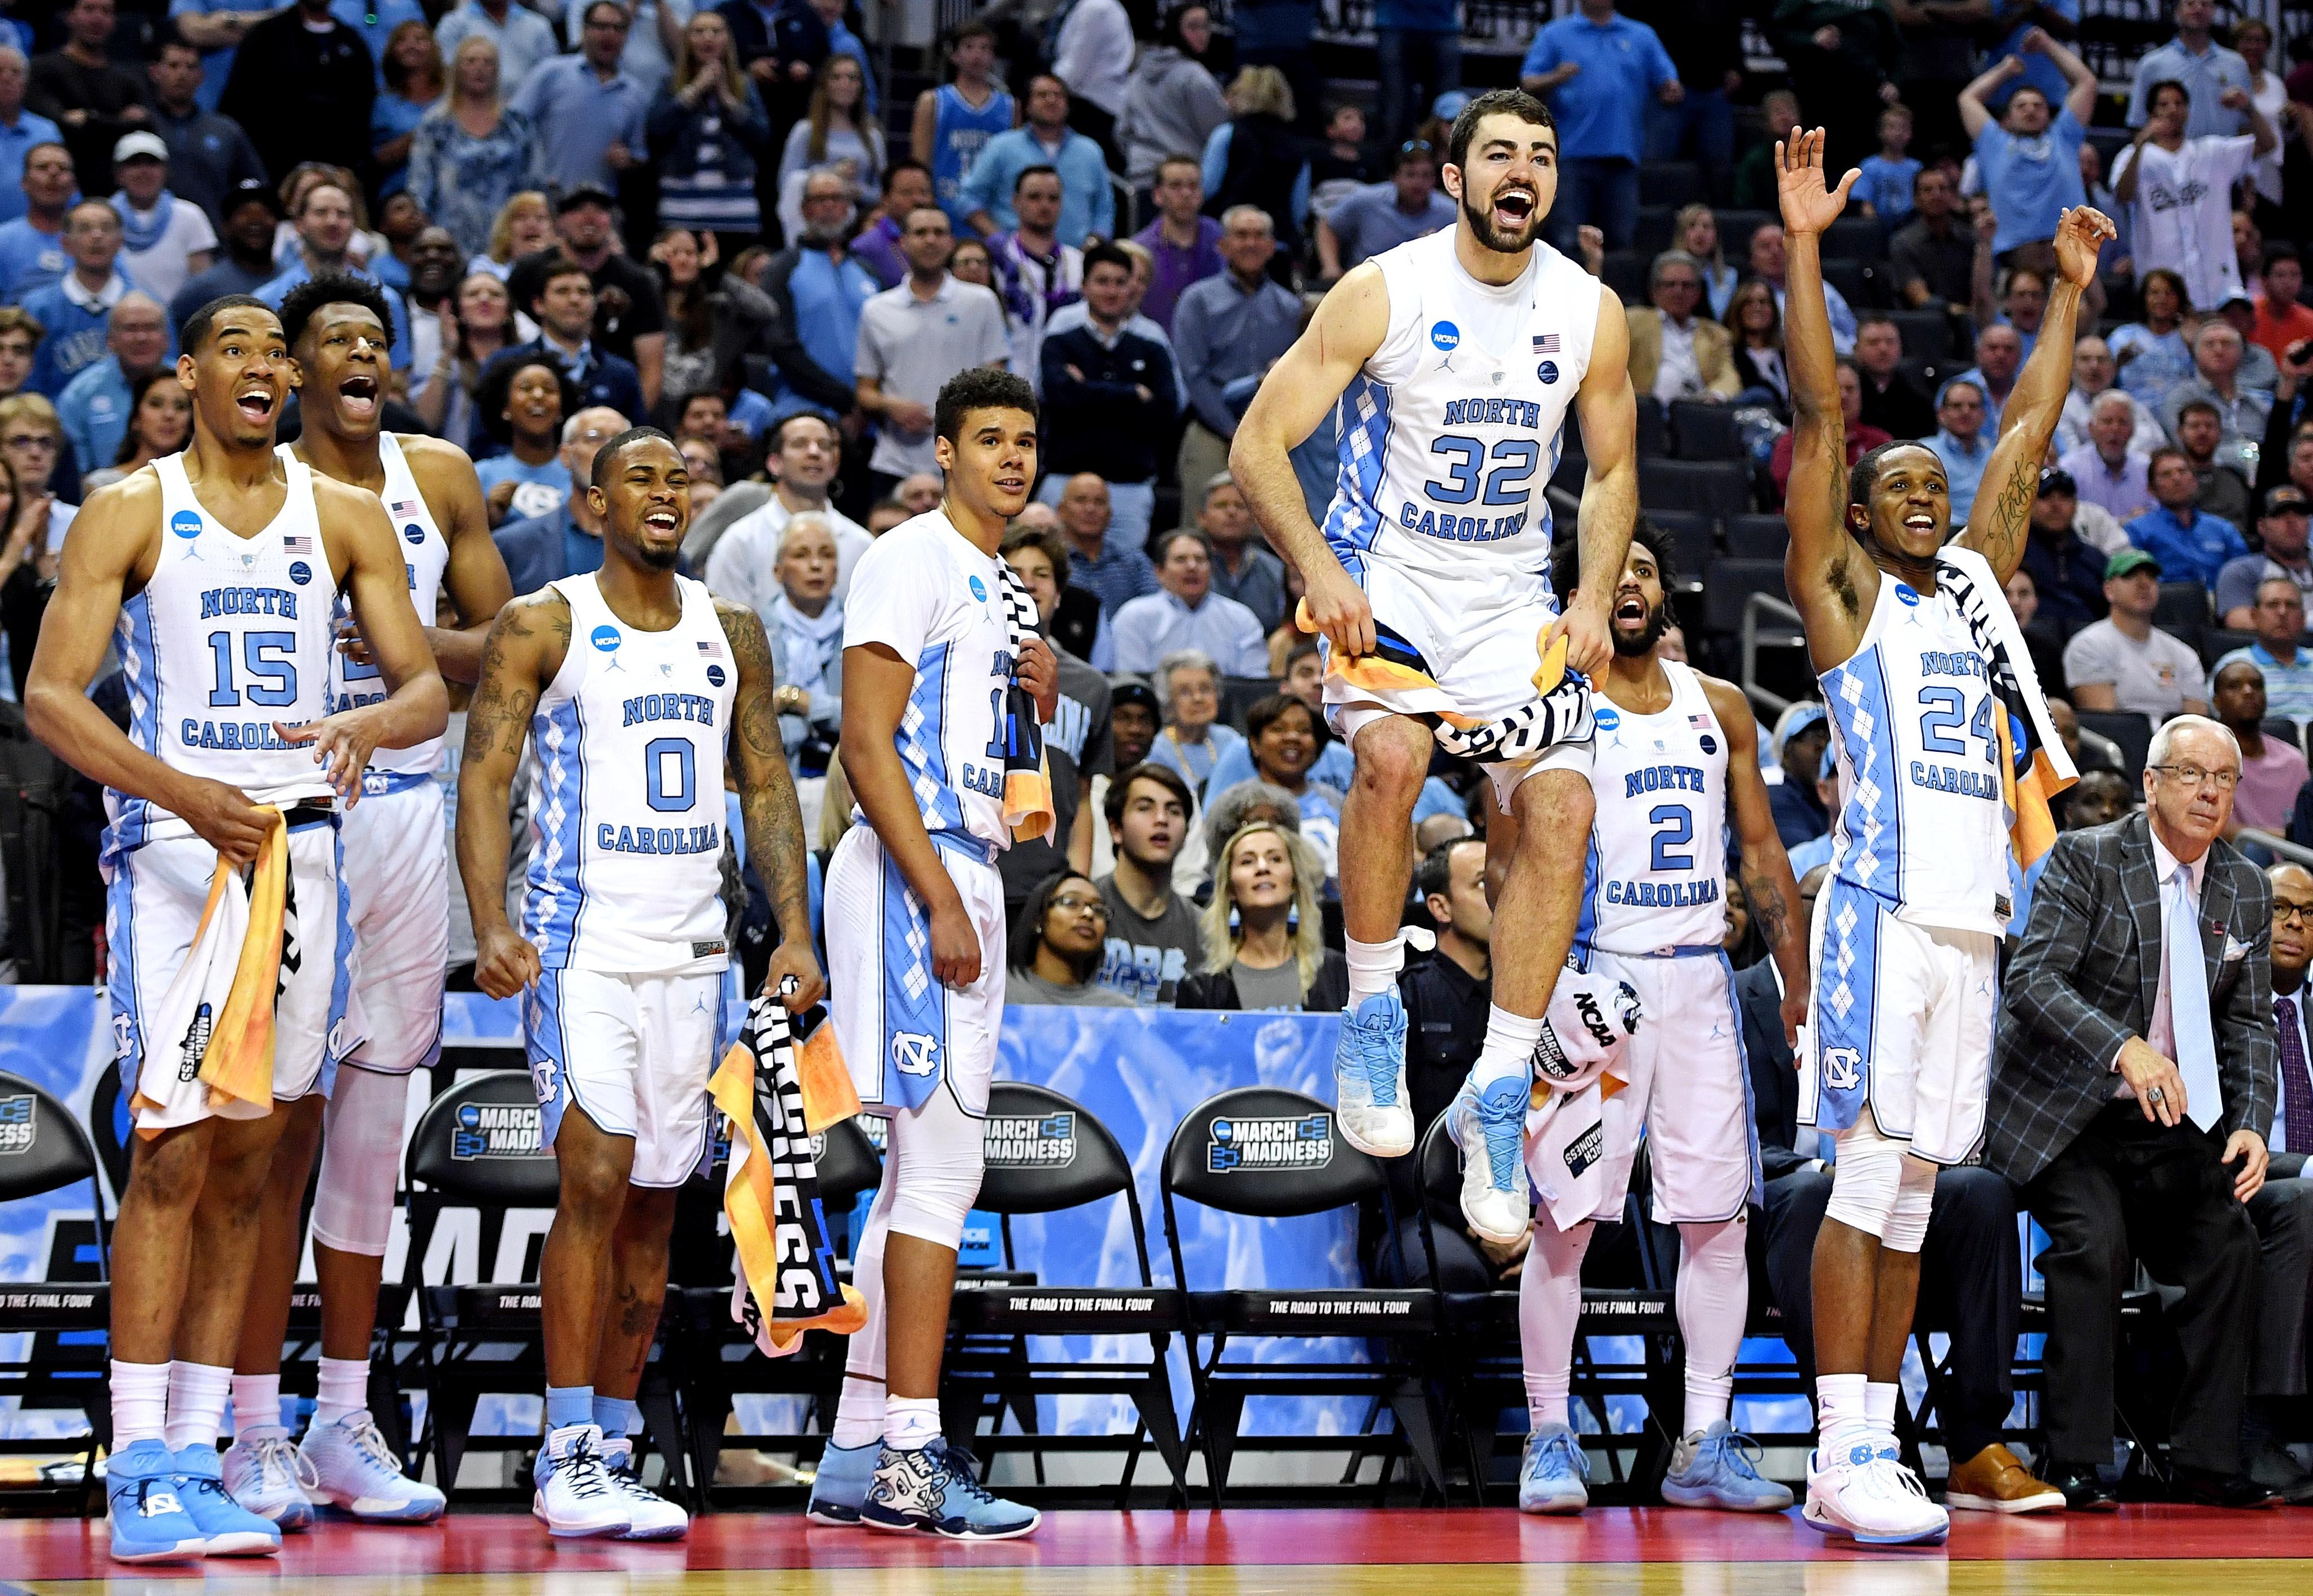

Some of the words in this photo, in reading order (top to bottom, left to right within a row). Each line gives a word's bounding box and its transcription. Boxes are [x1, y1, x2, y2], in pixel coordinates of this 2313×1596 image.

[1434, 333, 1458, 345] NCAA
[1444, 398, 1540, 429] NORTH
[1424, 434, 1540, 505] 32
[174, 523, 201, 532] NCAA
[1400, 502, 1529, 541] CAROLIN
[201, 587, 297, 620] NORTH
[1898, 592, 1919, 603] NCAA
[595, 637, 620, 646] NCAA
[208, 631, 297, 707] 15
[623, 693, 714, 727] NORTH
[1598, 718, 1618, 726] NCAA
[1918, 686, 1996, 764] 24
[645, 737, 695, 812] 0
[1625, 765, 1705, 799] NORTH
[598, 823, 719, 855] CAROLINA
[1649, 804, 1693, 871] 2
[1606, 877, 1719, 908] CAROLINA
[1573, 993, 1617, 1048] NCAA
[1541, 1026, 1563, 1061] MARCH
[1232, 1121, 1297, 1142] MARCH
[985, 1138, 1073, 1159] MADNESS
[1242, 1139, 1330, 1161] MADNESS
[7, 1295, 29, 1308] THE
[30, 1295, 61, 1308] FINAL
[62, 1295, 94, 1308] FOUR
[291, 1294, 306, 1307] HE
[499, 1296, 520, 1308] THE
[521, 1296, 542, 1308] ROA
[1010, 1298, 1029, 1311] THE
[1030, 1298, 1058, 1311] ROAD
[1059, 1299, 1073, 1311] TO
[1075, 1299, 1094, 1311] THE
[1095, 1299, 1123, 1311] FINAL
[1125, 1299, 1153, 1311] FOUR
[1270, 1301, 1289, 1313] THE
[1290, 1301, 1318, 1314] ROAD
[1319, 1301, 1332, 1314] TO
[1333, 1301, 1352, 1314] THE
[1353, 1301, 1381, 1314] FINAL
[1383, 1301, 1410, 1314] FOUR
[1590, 1302, 1608, 1314] THE
[1609, 1301, 1636, 1314] FINAL
[1638, 1301, 1665, 1314] FOUR
[907, 1451, 934, 1477] UNC
